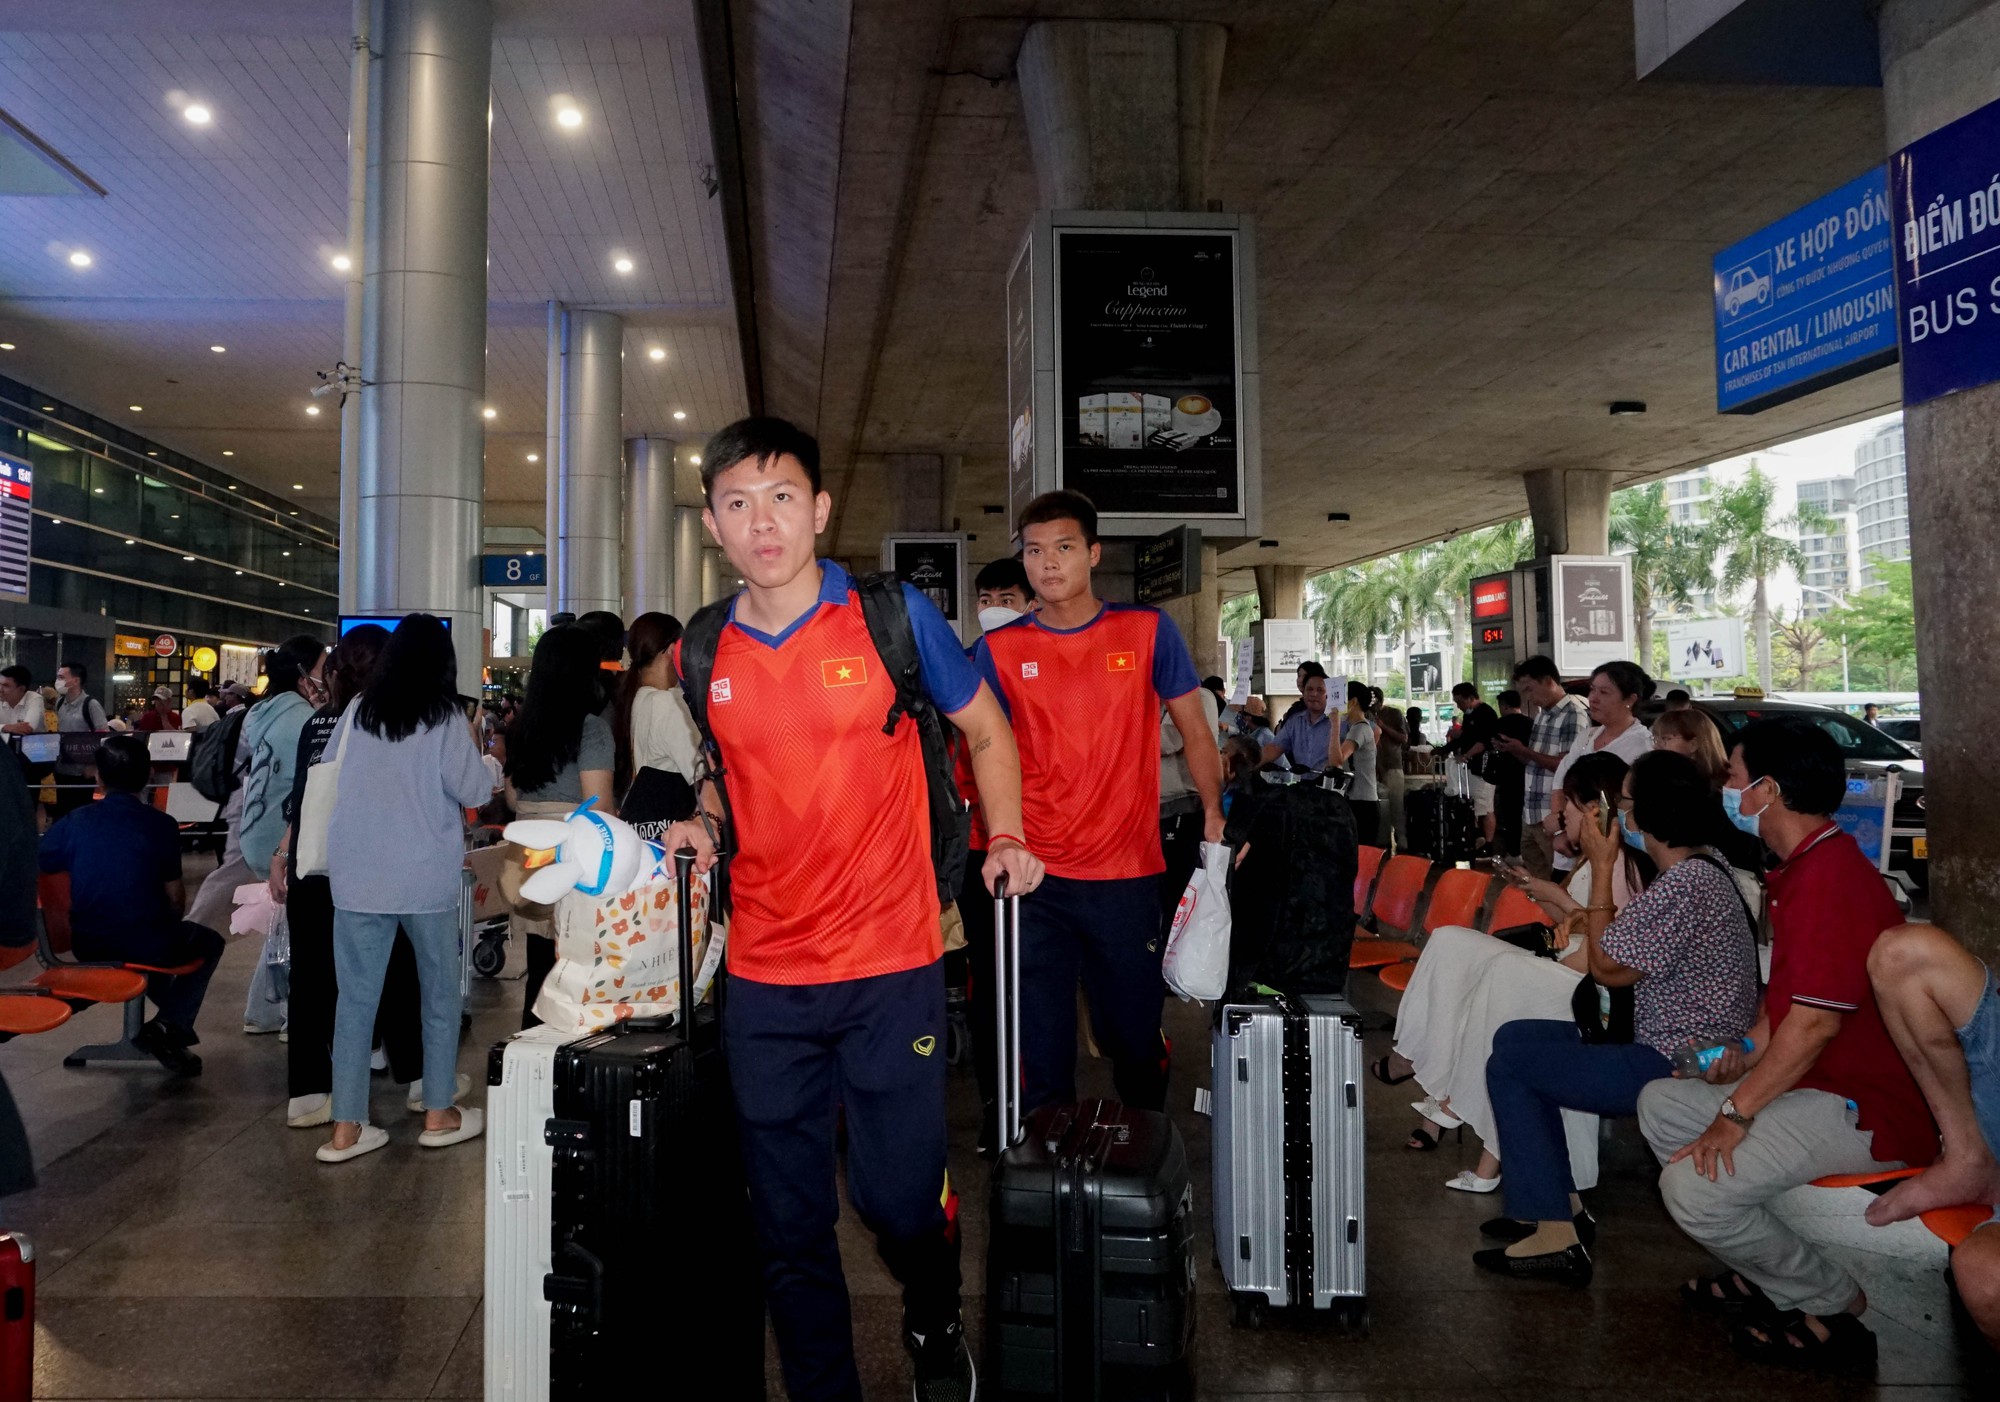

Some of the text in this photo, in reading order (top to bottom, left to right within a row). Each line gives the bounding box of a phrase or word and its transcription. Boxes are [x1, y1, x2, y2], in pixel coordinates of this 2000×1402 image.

[1775, 188, 1890, 274] XE HỢP ĐỒN
[1904, 174, 2000, 262] ĐIỂM ĐÓ
[1128, 284, 1168, 298] Legend
[1104, 299, 1188, 320] Cappuccino
[1908, 275, 2000, 344] BUS S
[1724, 346, 1748, 374] CAR
[1752, 323, 1802, 364] RENTAL
[1814, 284, 1894, 339] LIMOUSIN
[1724, 323, 1879, 393] FRANCHISES OF TSN INTERNATIONAL AIRPORT
[506, 558, 522, 580] 8
[1476, 592, 1507, 605] GAMUDA LAND
[1484, 629, 1503, 643] 15:41
[595, 823, 613, 851] BOREY
